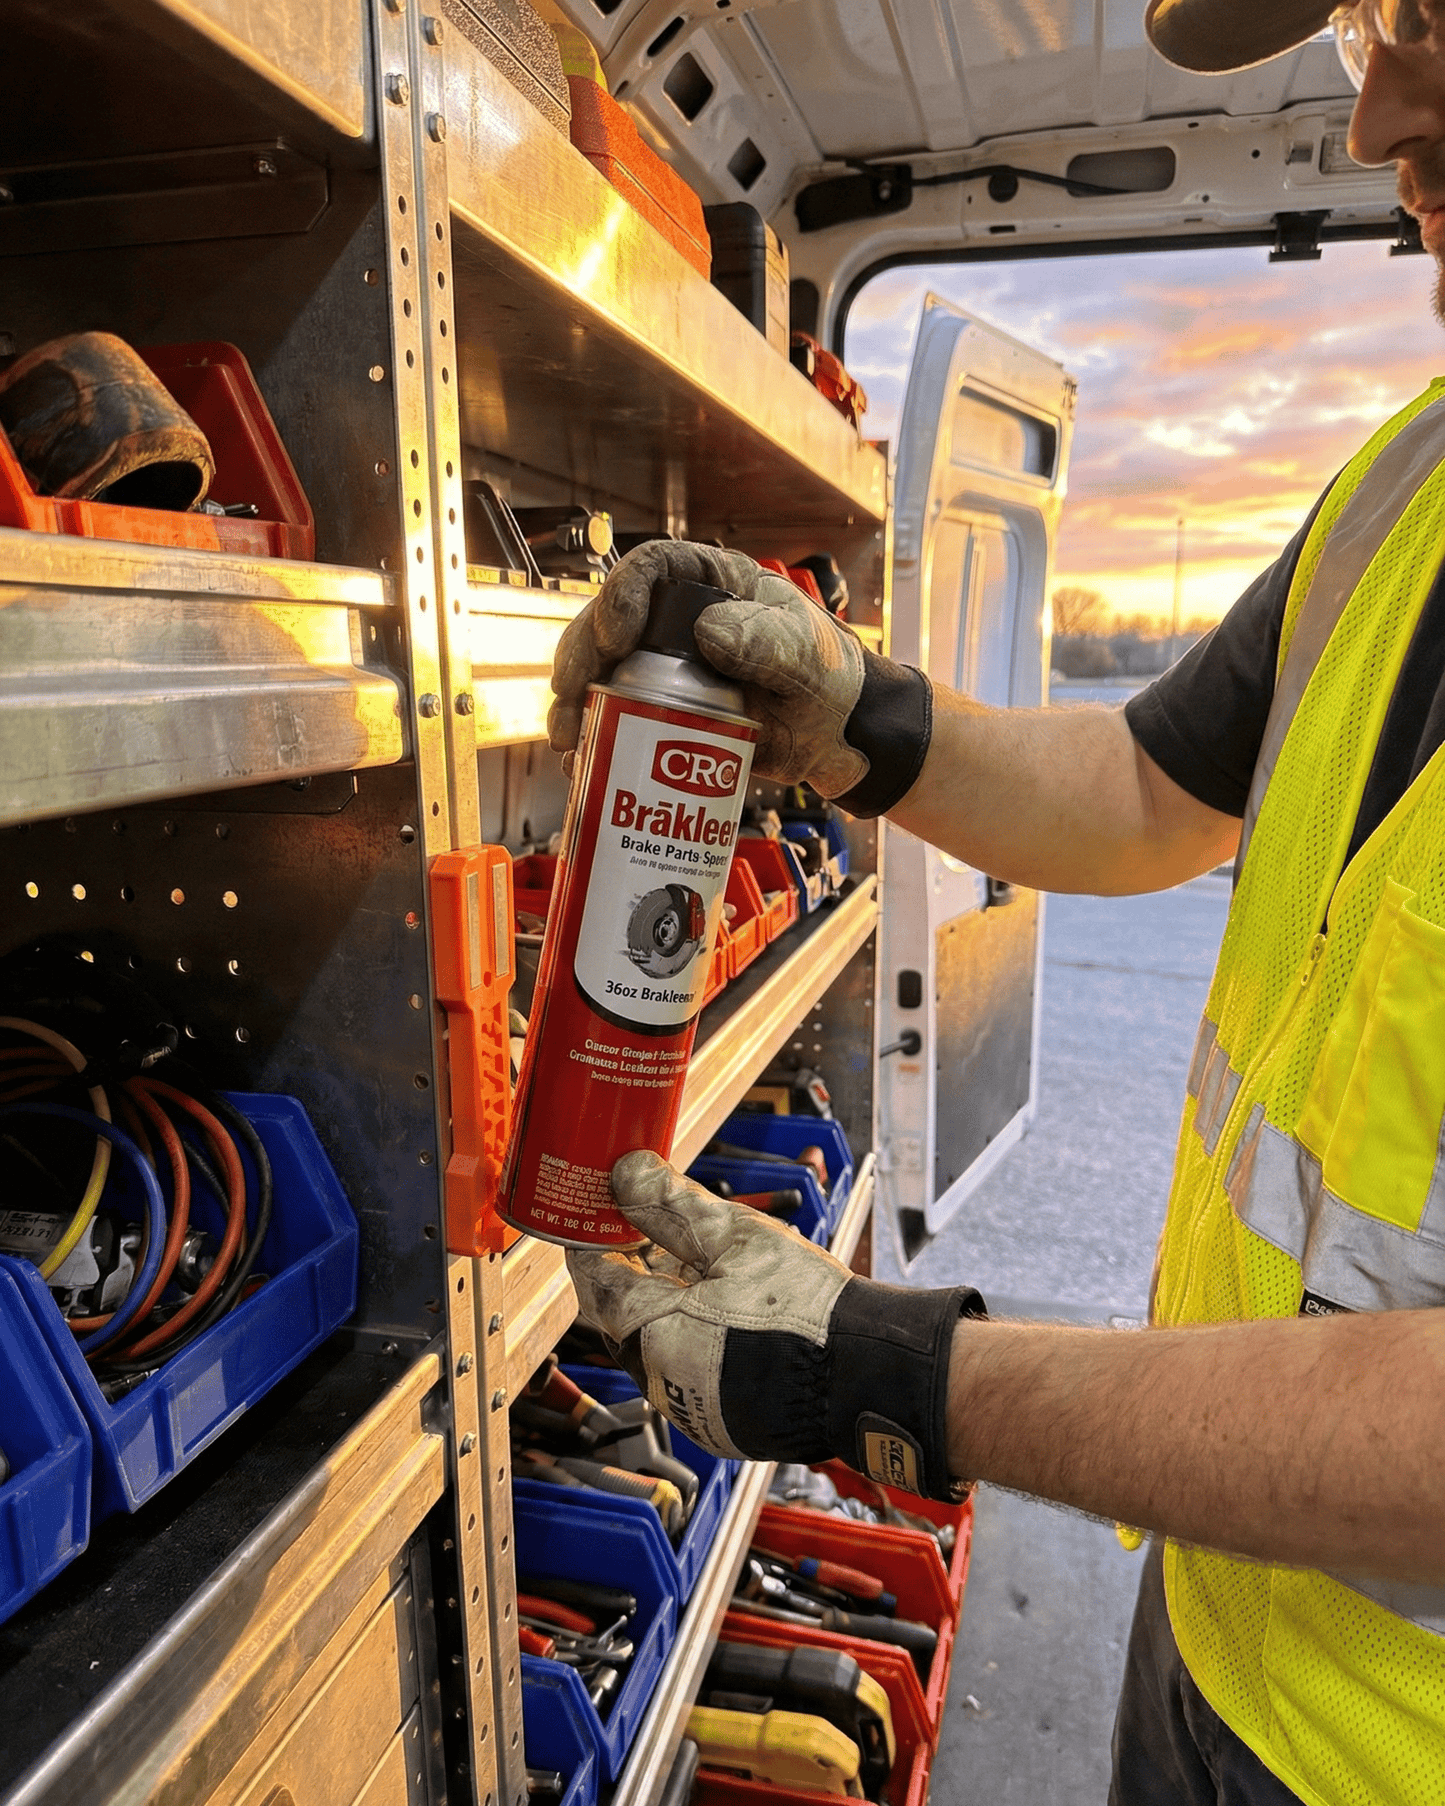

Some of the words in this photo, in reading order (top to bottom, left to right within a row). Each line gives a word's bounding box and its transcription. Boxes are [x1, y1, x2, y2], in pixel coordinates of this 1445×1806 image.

[660, 748, 738, 790] CRC
[621, 834, 661, 856] Brake
[665, 844, 700, 863] Parts
[605, 979, 639, 999] 36oz
[583, 1221, 596, 1233] OZ
